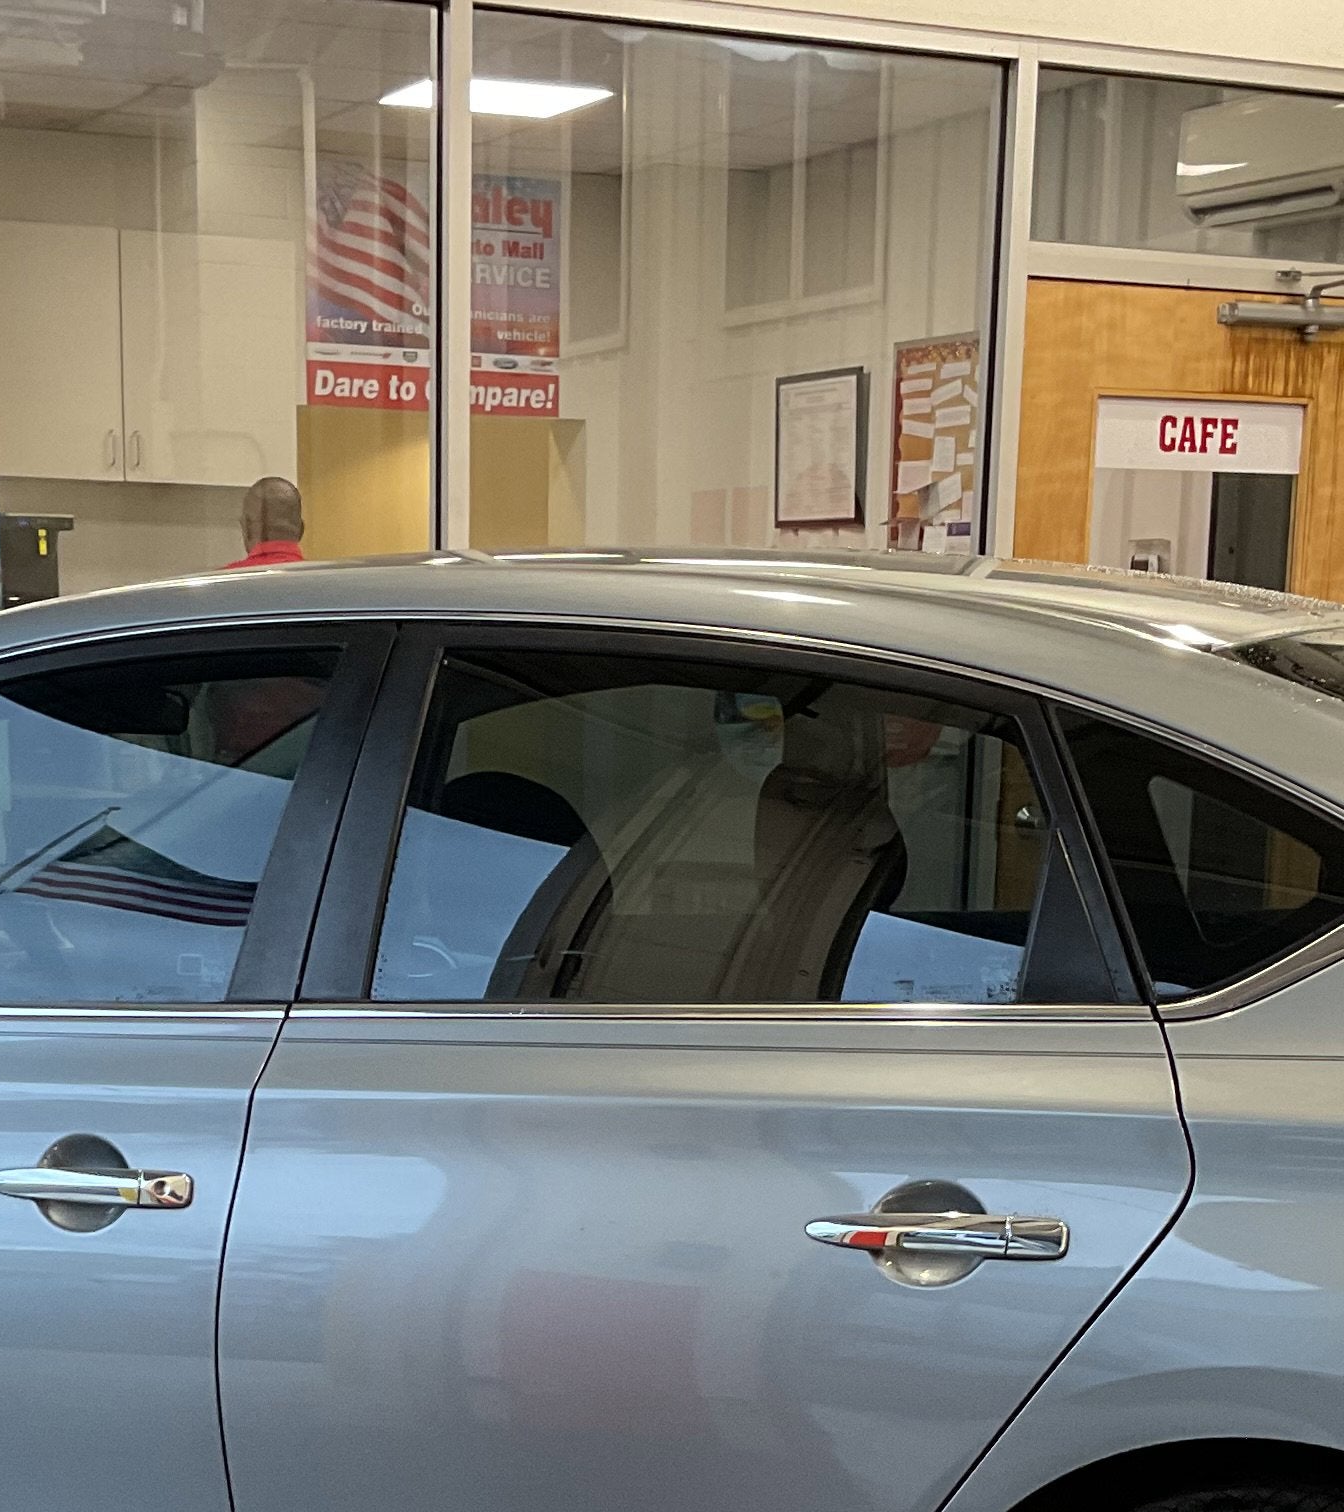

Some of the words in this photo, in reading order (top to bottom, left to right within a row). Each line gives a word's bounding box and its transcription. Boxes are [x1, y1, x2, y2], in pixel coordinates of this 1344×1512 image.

[472, 239, 495, 257] to
[502, 240, 544, 261] Mall
[475, 262, 551, 289] RVICE
[316, 316, 368, 333] factory
[372, 319, 423, 335] trained
[496, 328, 551, 343] vehicle!
[314, 369, 380, 399] Dare
[389, 374, 417, 401] to
[1159, 414, 1239, 455] CAFE
